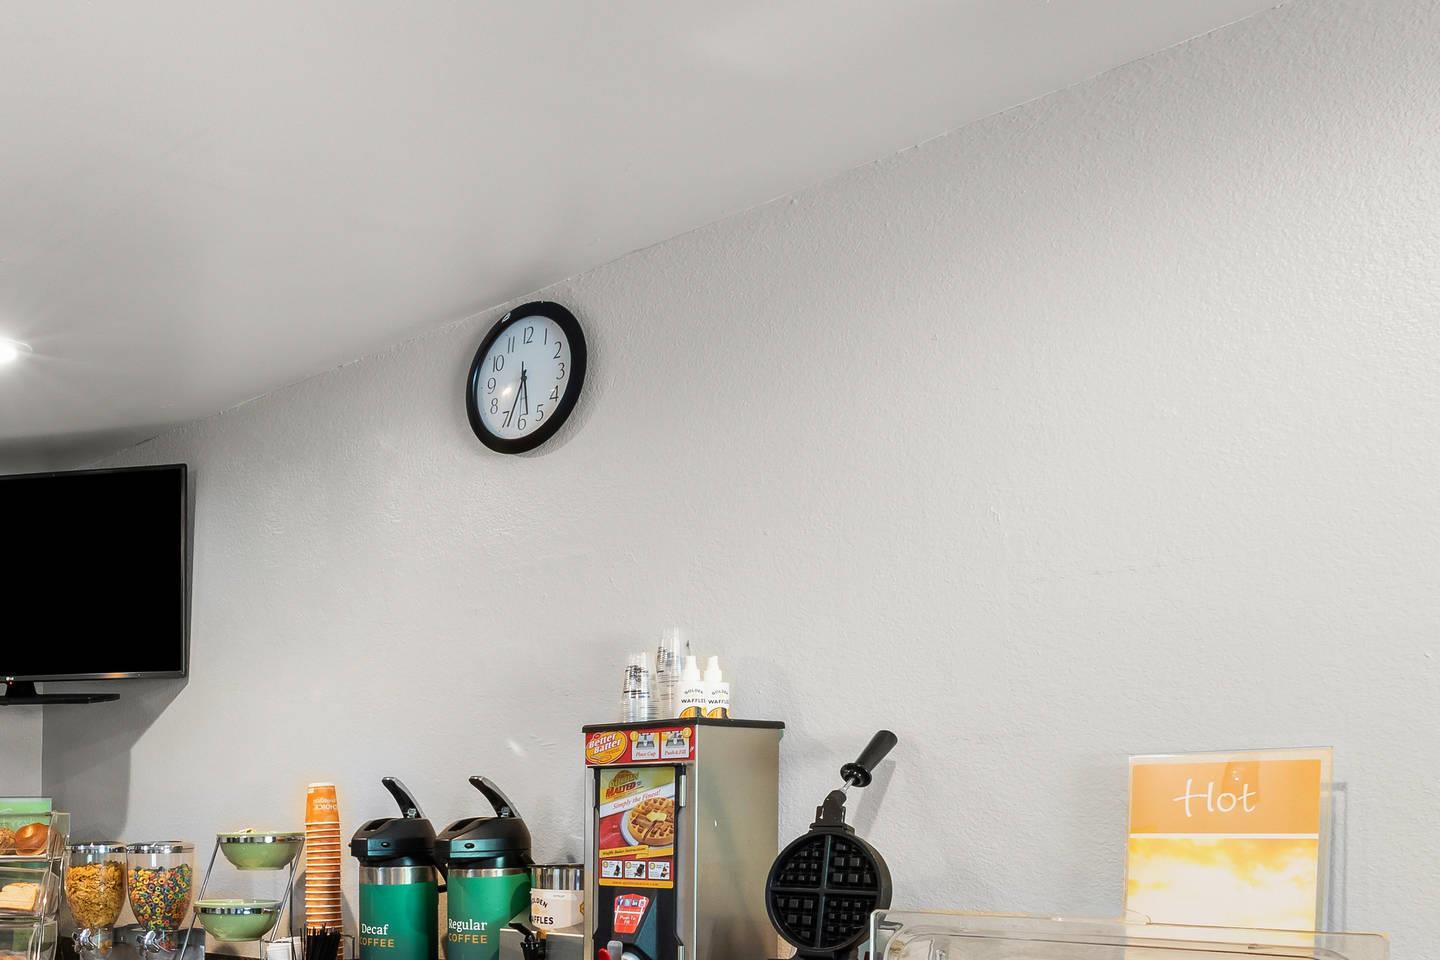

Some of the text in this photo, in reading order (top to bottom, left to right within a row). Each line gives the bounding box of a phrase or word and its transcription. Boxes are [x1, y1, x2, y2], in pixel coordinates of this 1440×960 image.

[523, 326, 534, 345] 12
[544, 328, 548, 345] 1
[507, 336, 515, 354] 11
[553, 341, 562, 359] 2
[493, 354, 505, 373] 10
[556, 362, 565, 380] 3
[488, 377, 497, 395] 9
[549, 385, 559, 402] 4
[490, 398, 498, 414] 8
[536, 403, 544, 422] 5
[502, 411, 510, 428] 7
[517, 413, 528, 430] 6
[589, 731, 617, 749] Better
[594, 739, 621, 754] Batter
[1173, 778, 1257, 817] Hot
[361, 923, 389, 935] Decaf
[448, 919, 488, 933] Regular
